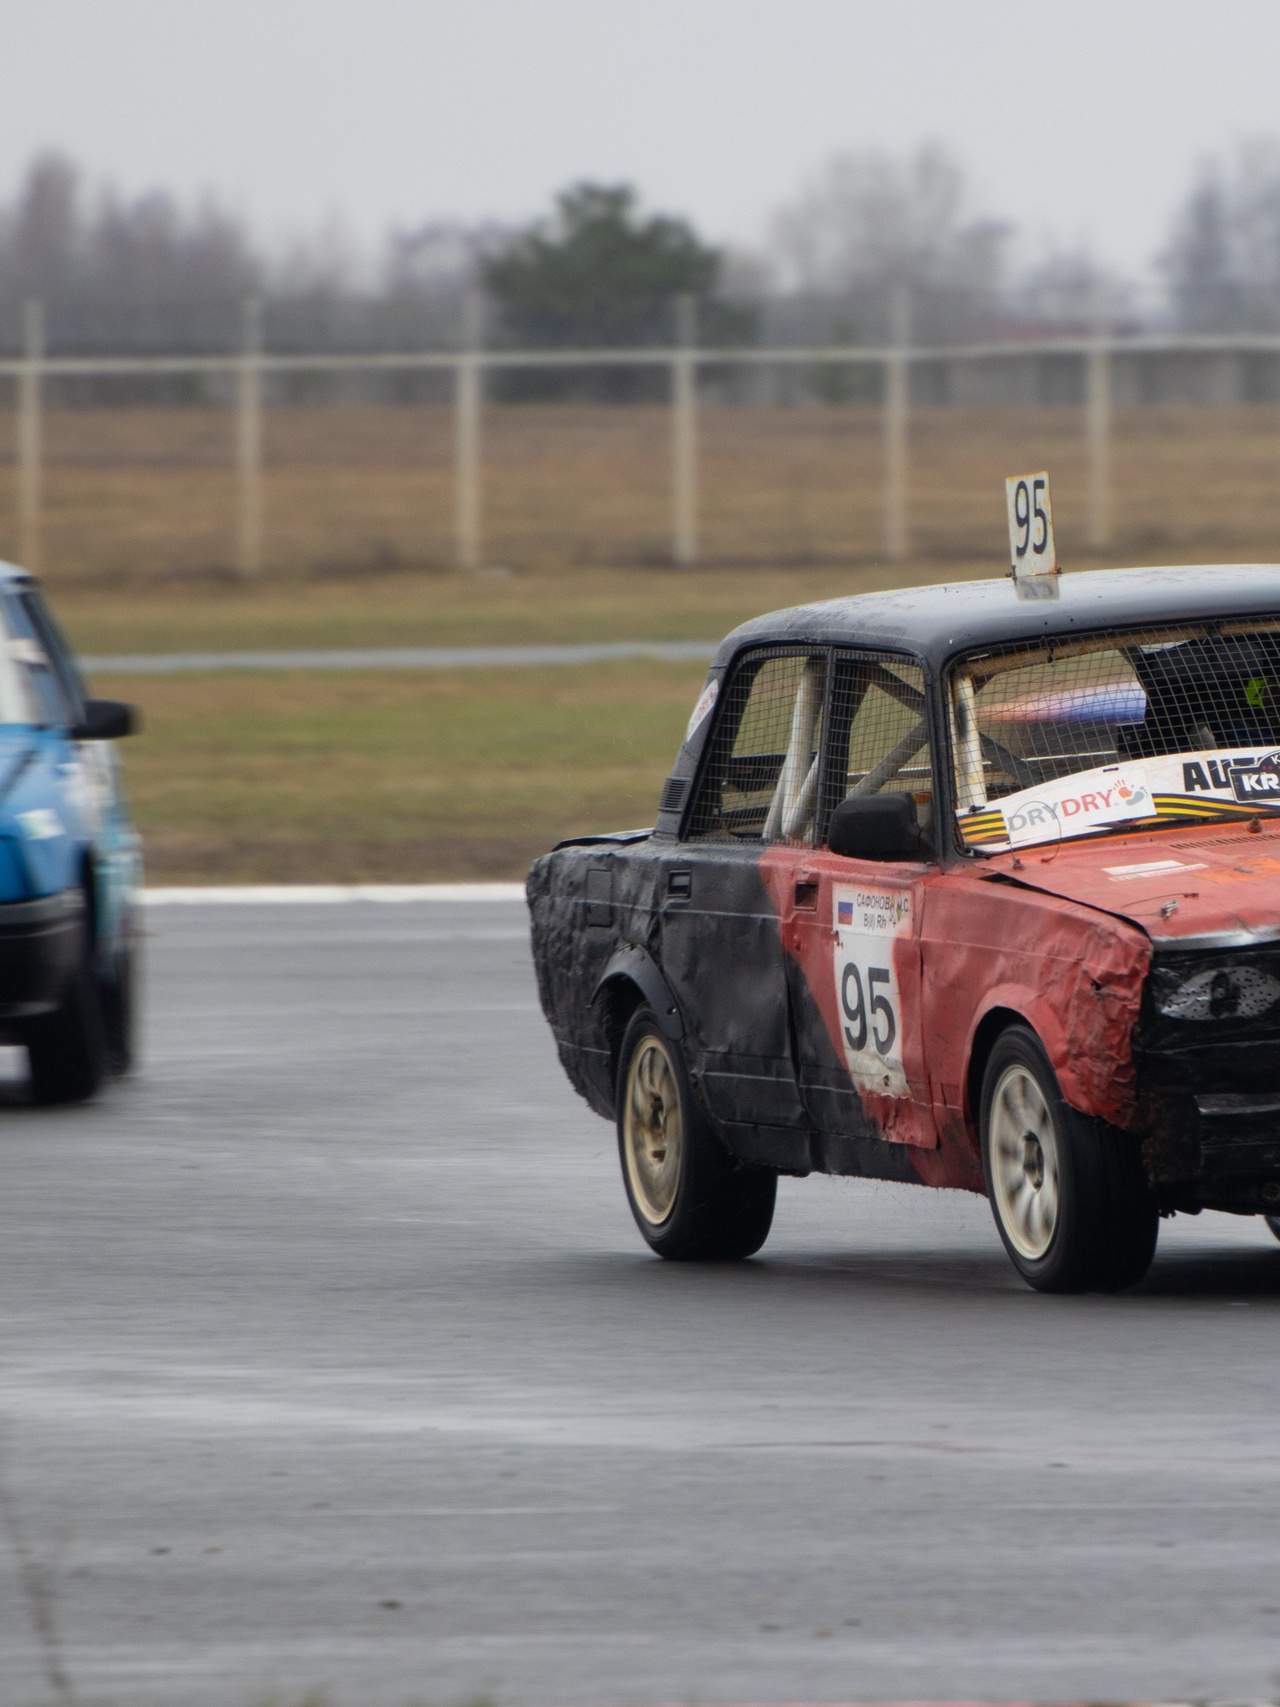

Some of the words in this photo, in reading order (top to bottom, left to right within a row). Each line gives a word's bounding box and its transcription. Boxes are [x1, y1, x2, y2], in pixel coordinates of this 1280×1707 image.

[1014, 479, 1048, 557] 95
[1007, 788, 1113, 832] DRYDRY
[841, 962, 896, 1055] 95
